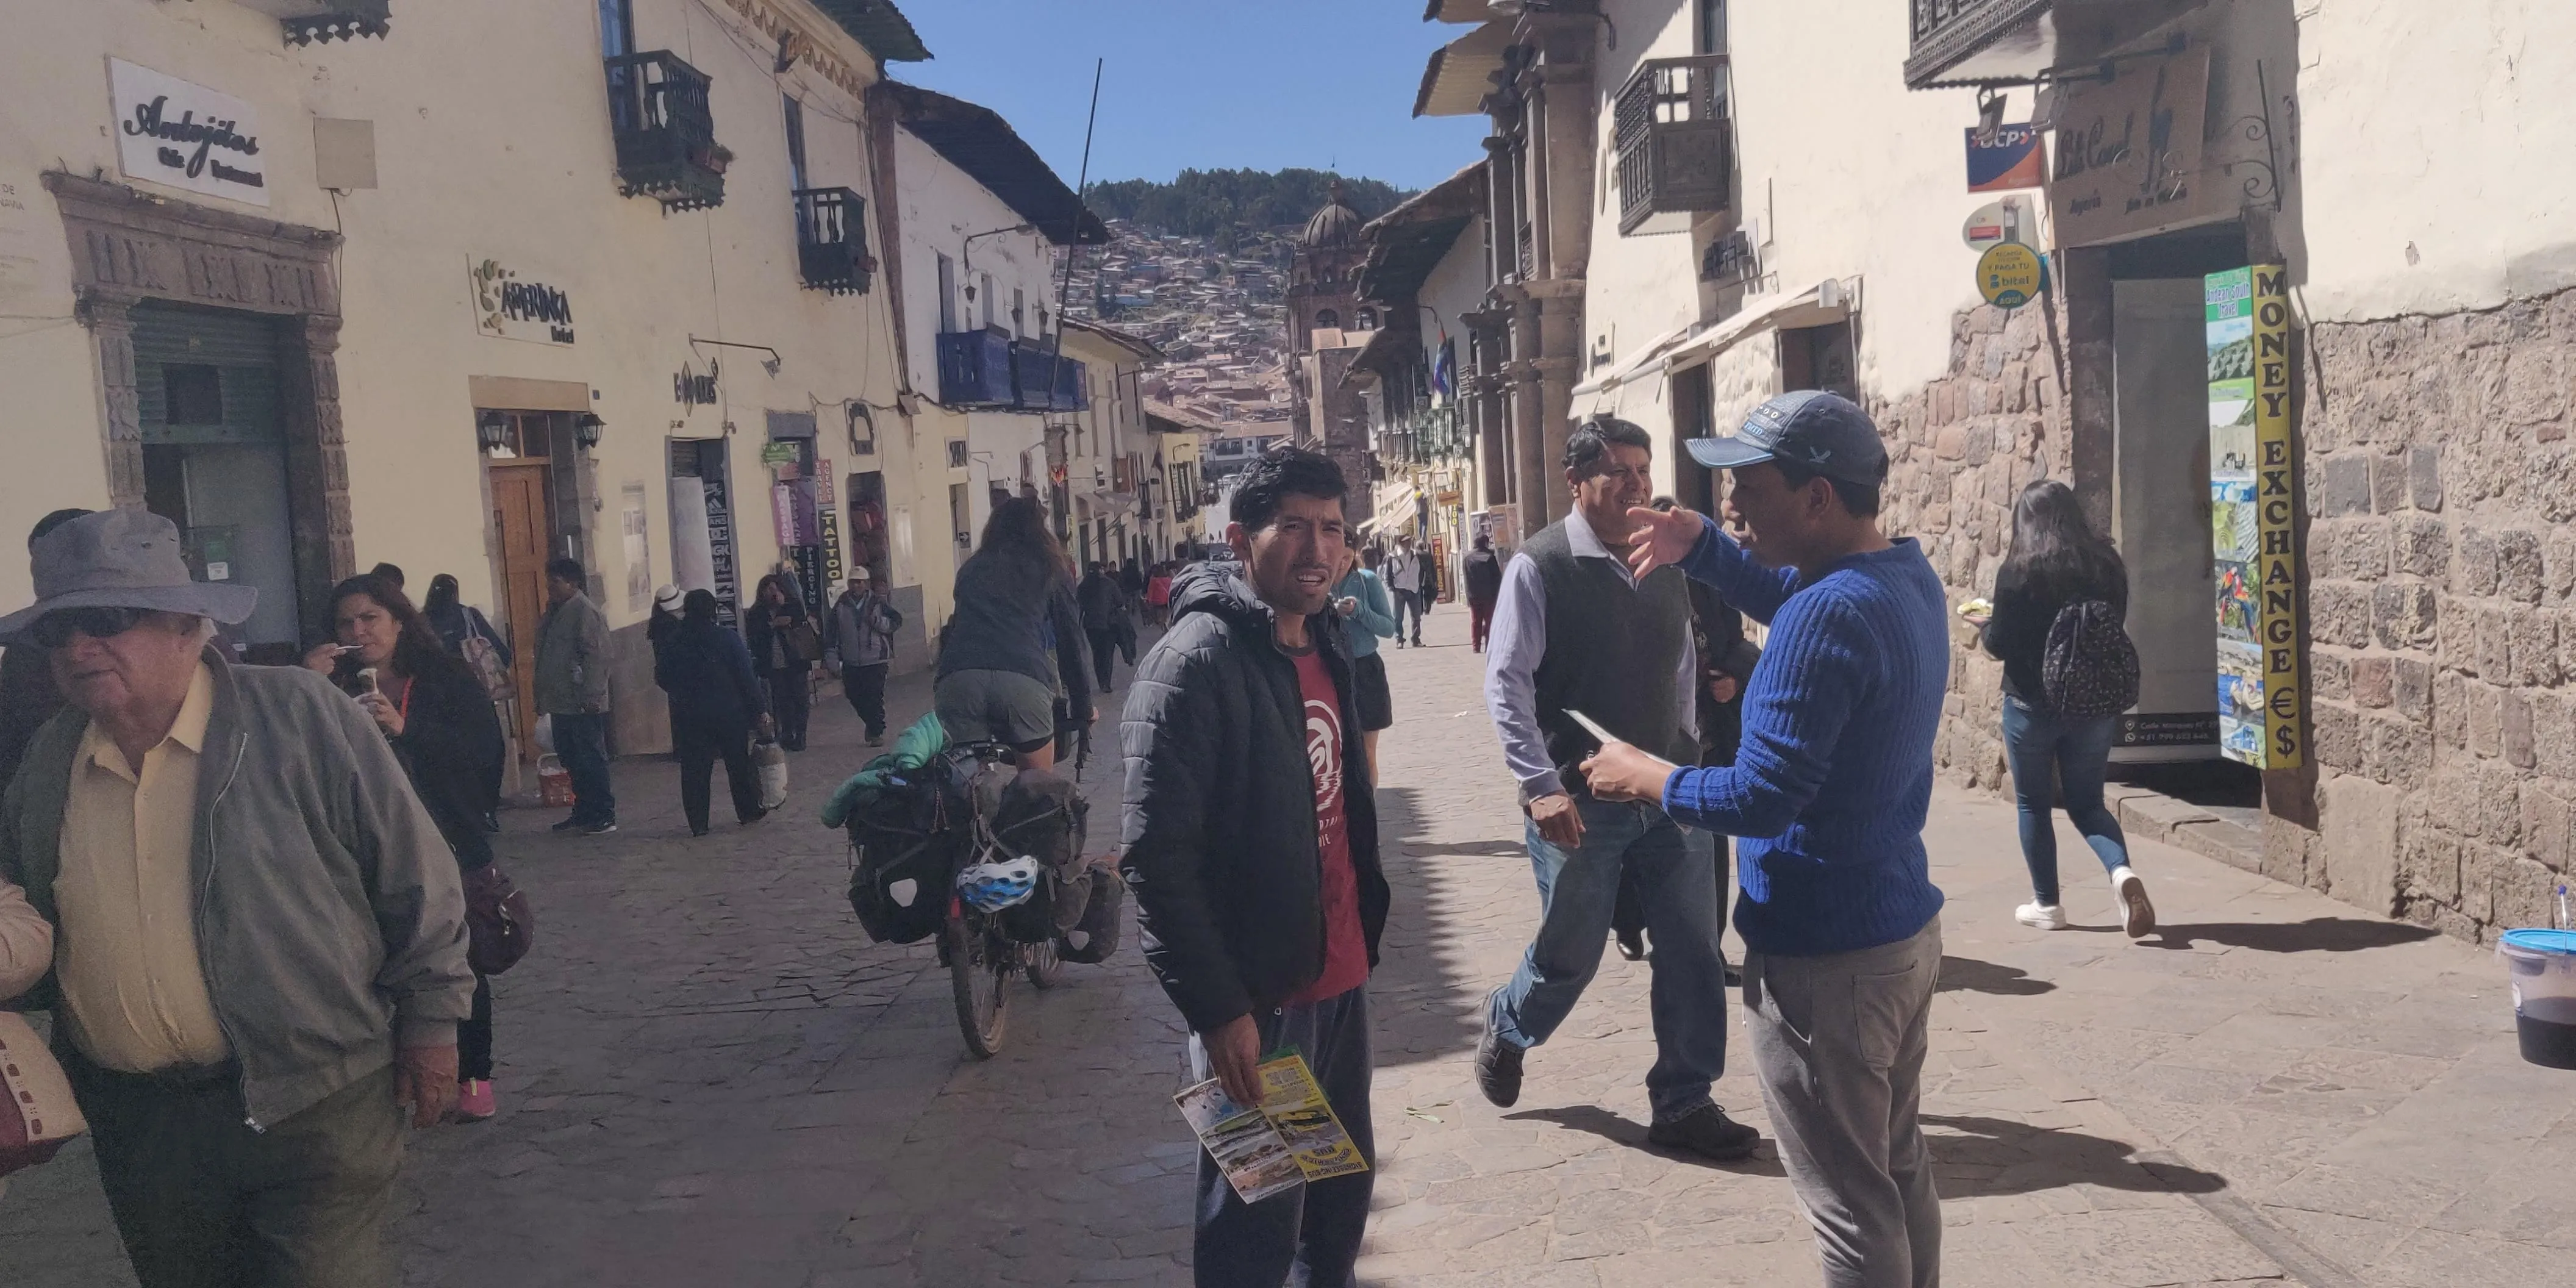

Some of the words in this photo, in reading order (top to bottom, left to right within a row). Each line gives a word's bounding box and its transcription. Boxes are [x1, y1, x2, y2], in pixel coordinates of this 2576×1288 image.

[2256, 272, 2287, 417] MONEY
[821, 516, 840, 579] TATTOO
[2263, 440, 2292, 673] EXCHANGE
